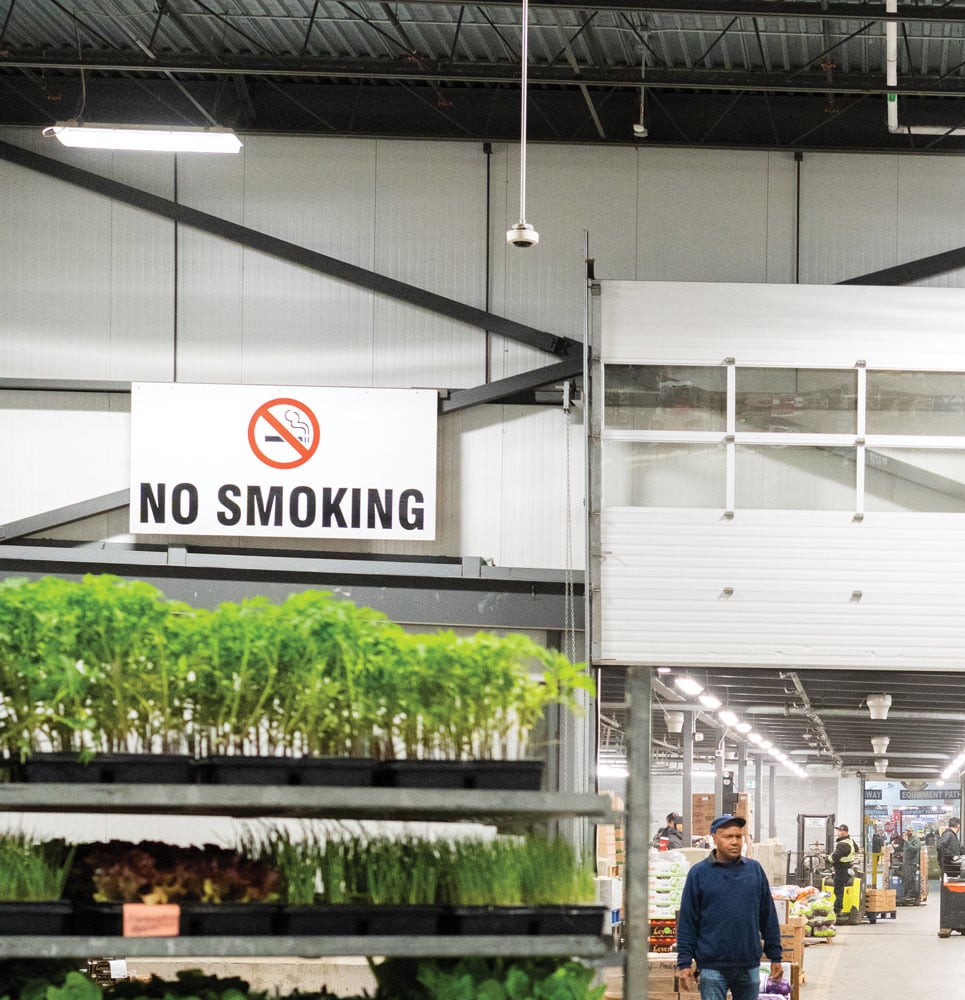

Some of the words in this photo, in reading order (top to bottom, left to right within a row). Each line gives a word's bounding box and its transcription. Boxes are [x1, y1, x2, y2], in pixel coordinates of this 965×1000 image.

[140, 482, 198, 525] NO
[217, 484, 426, 531] SMOKING
[902, 791, 941, 799] EQUIPMENT
